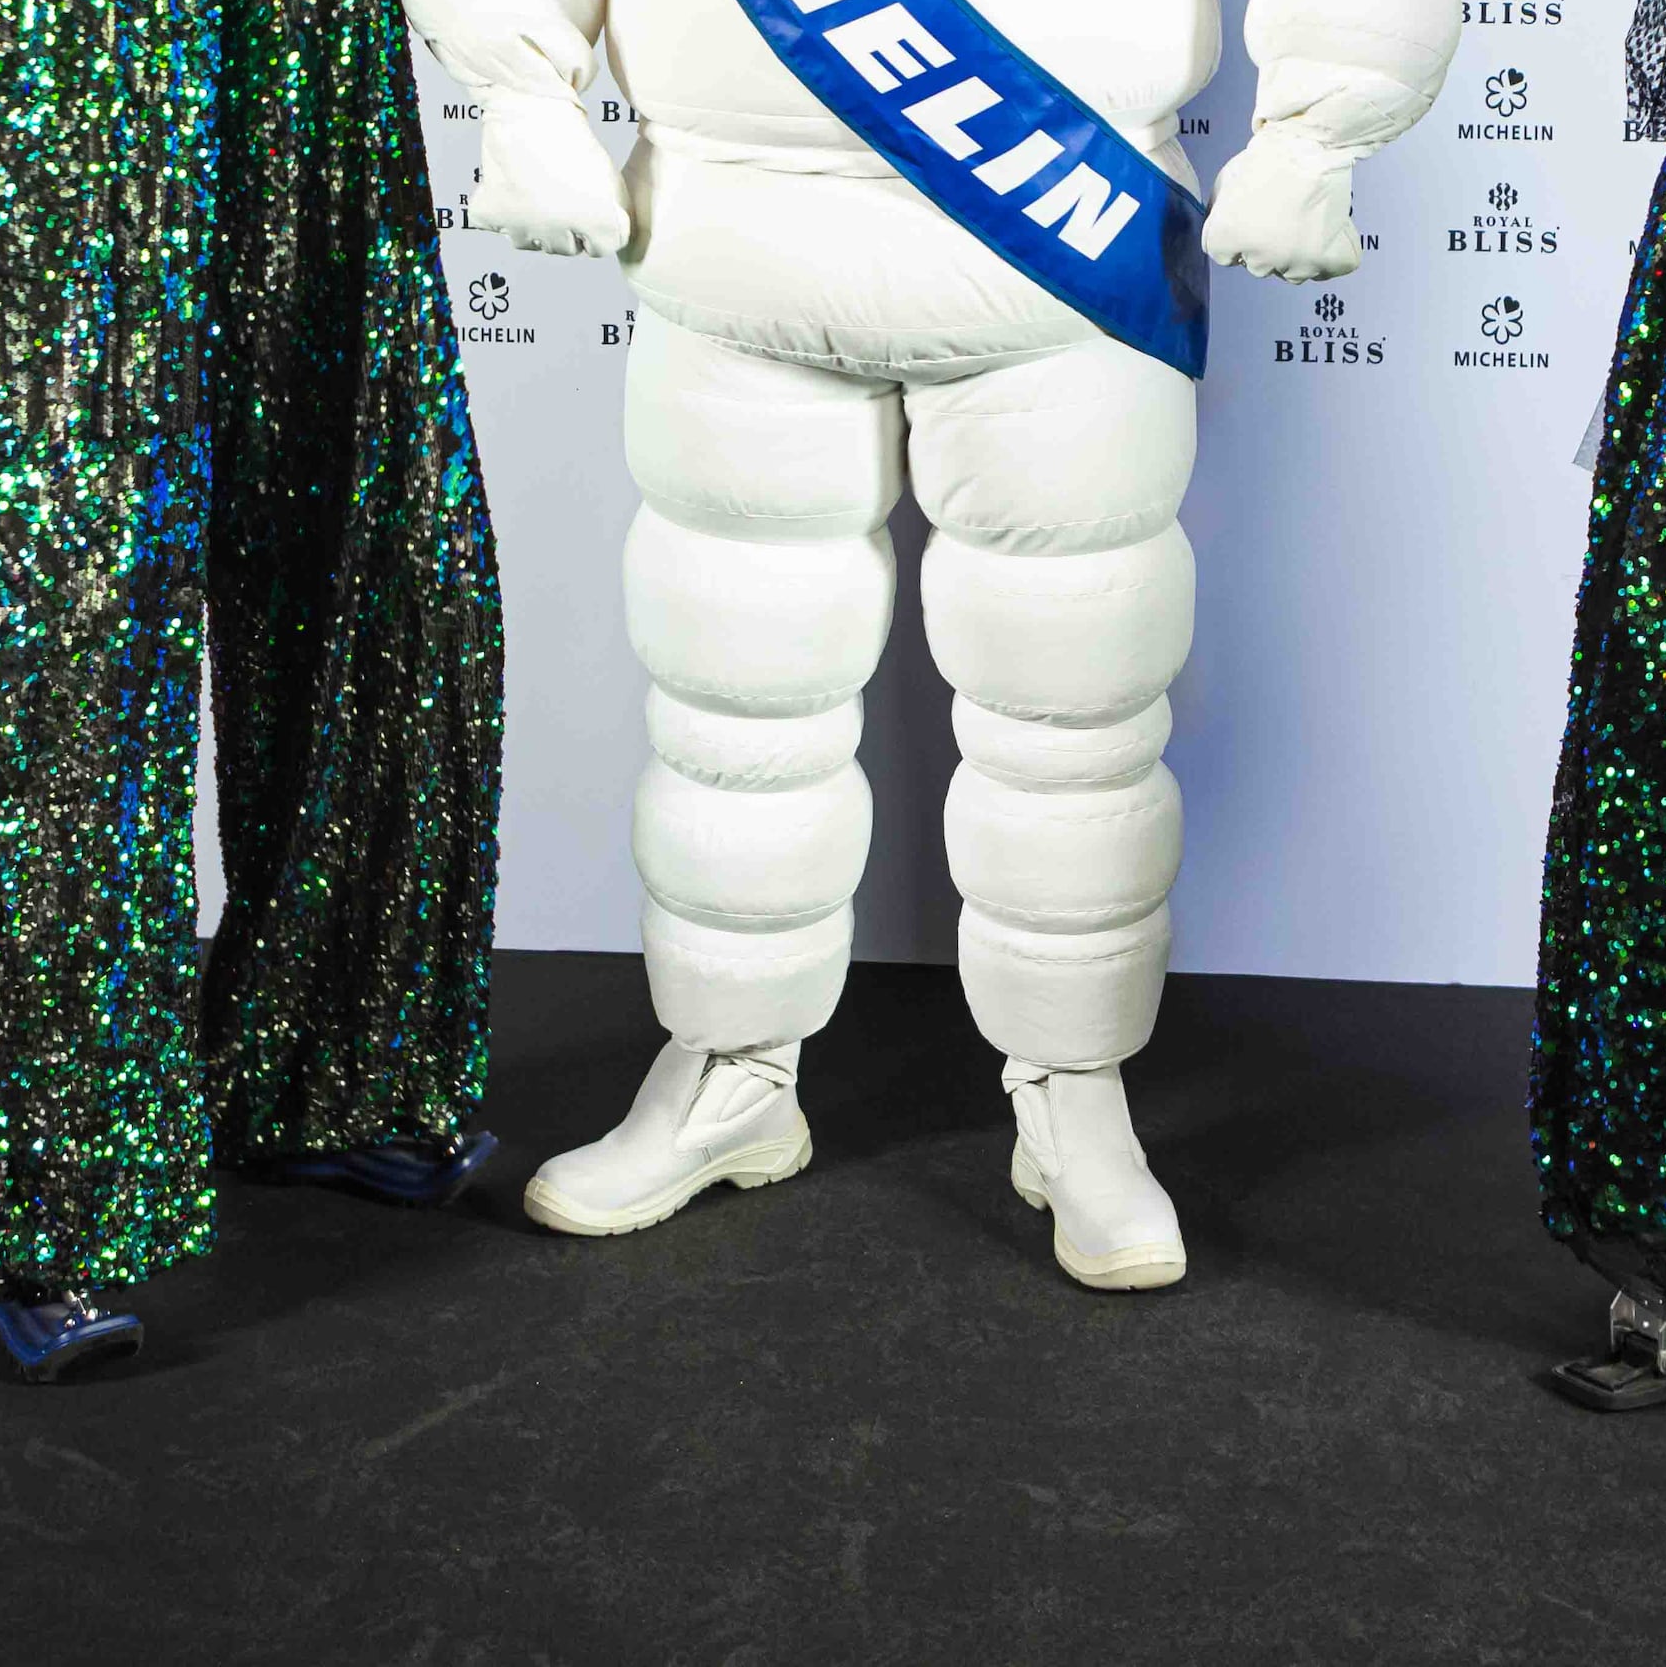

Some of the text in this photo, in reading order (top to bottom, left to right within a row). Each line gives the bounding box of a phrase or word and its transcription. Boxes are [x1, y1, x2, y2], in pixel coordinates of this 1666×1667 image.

[1458, 124, 1553, 141] MICHELIN
[1473, 214, 1533, 229] ROYAL
[1447, 230, 1557, 254] BLISS
[456, 327, 535, 344] ICHELIN
[1300, 325, 1359, 340] ROYAL
[1274, 340, 1384, 364] BLISS
[1454, 349, 1549, 368] MICHELIN
